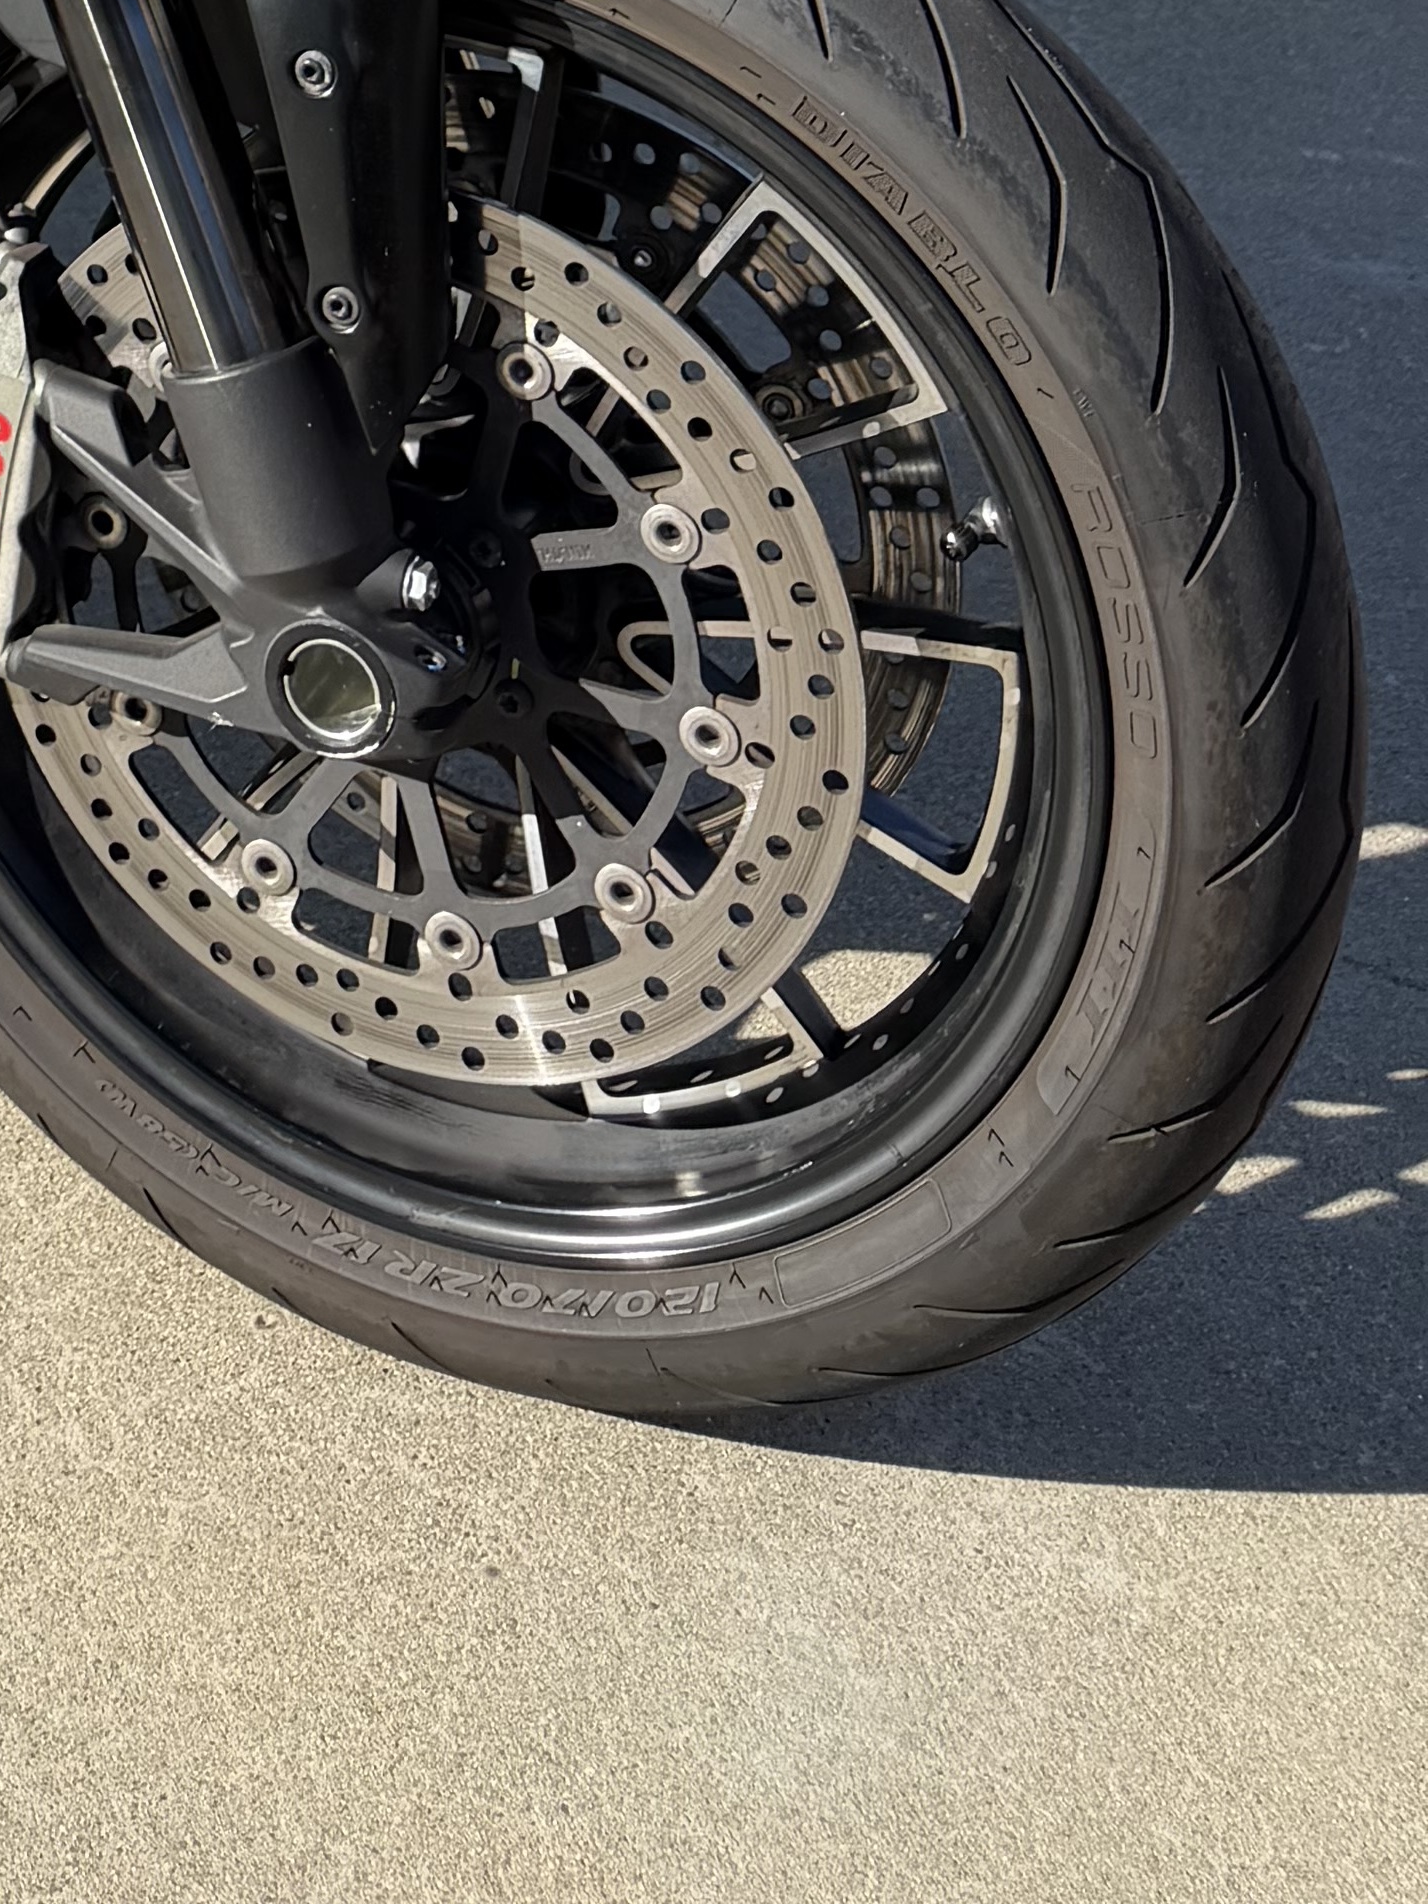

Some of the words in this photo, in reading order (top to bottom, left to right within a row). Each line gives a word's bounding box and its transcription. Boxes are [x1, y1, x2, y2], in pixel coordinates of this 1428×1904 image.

[790, 94, 1033, 367] DIABLO
[1072, 482, 1158, 759] ROSSO
[384, 1247, 484, 1298] ZR
[494, 1280, 722, 1319] 120/70
